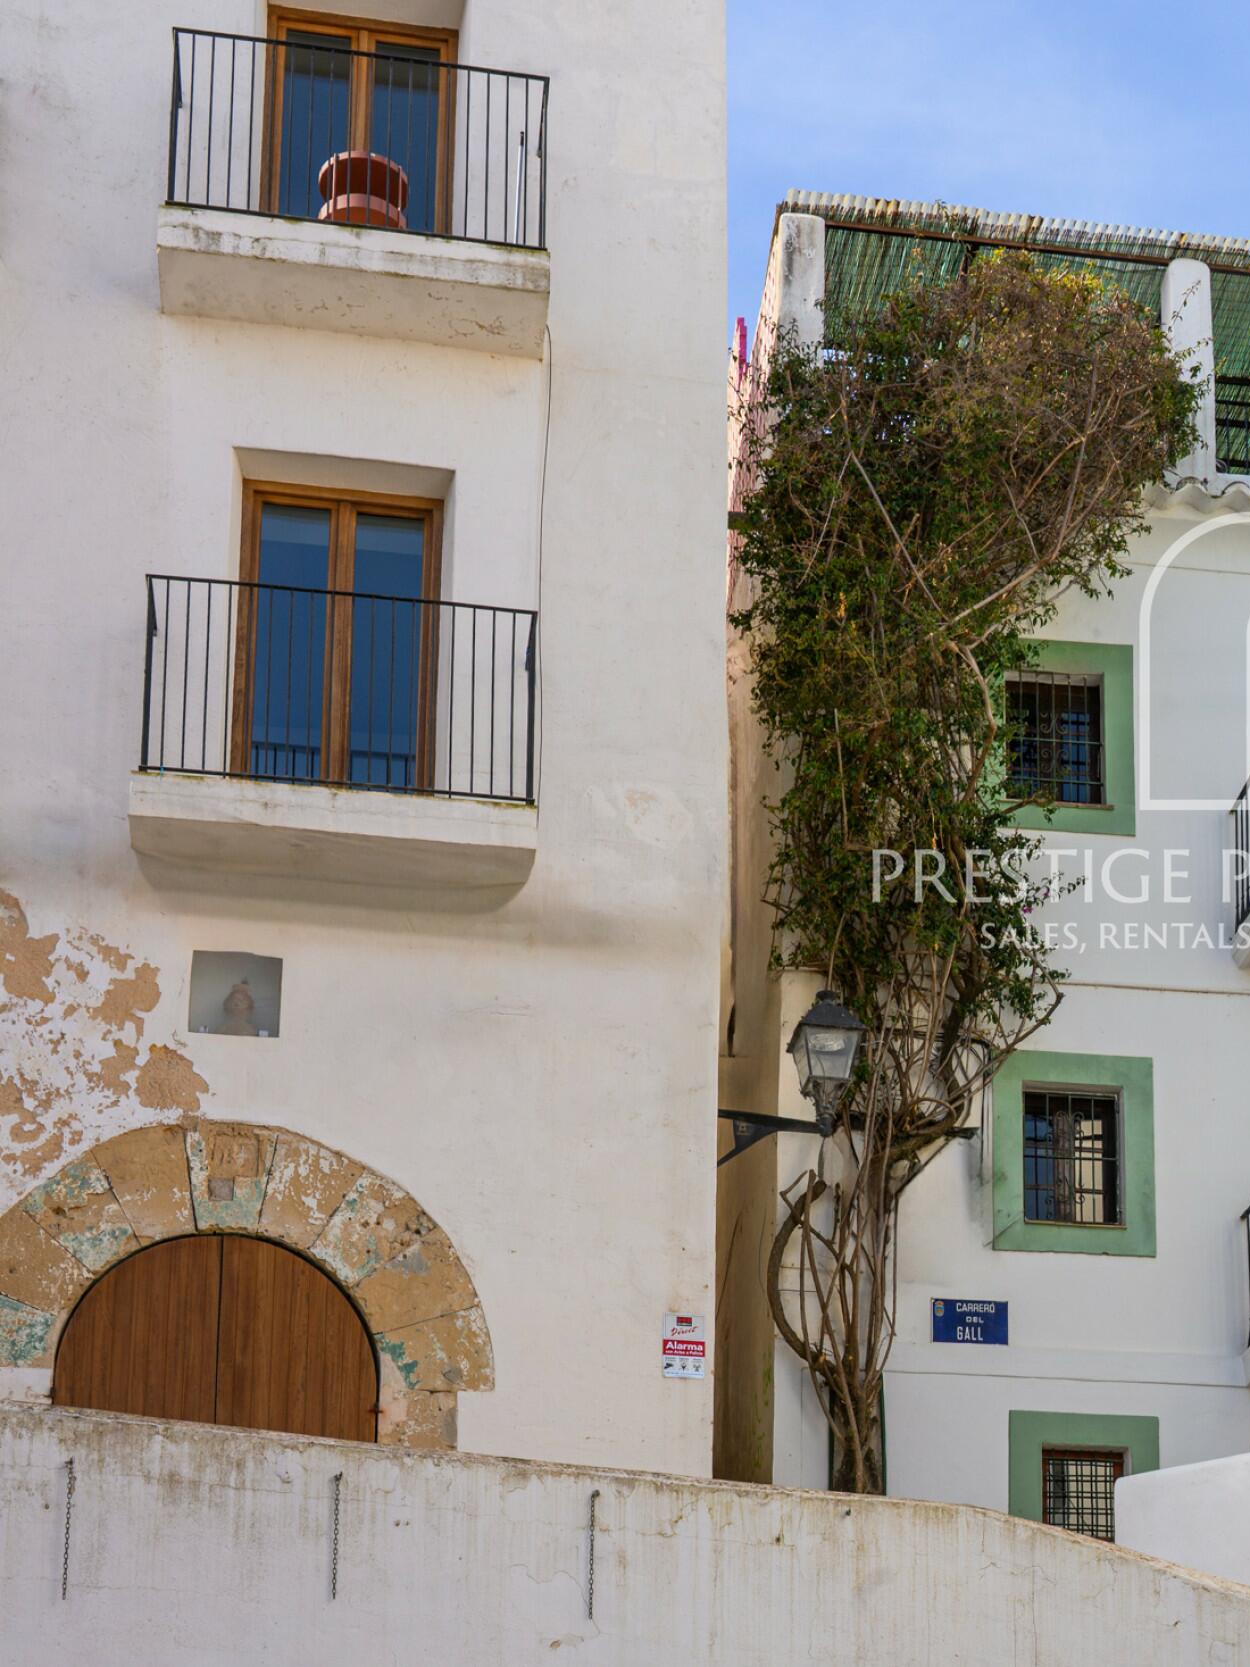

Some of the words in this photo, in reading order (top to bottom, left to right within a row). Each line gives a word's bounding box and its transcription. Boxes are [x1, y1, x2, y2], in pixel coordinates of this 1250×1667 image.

[965, 1316, 984, 1324] DEL
[956, 1326, 984, 1341] GALL
[665, 1341, 703, 1351] Alarma
